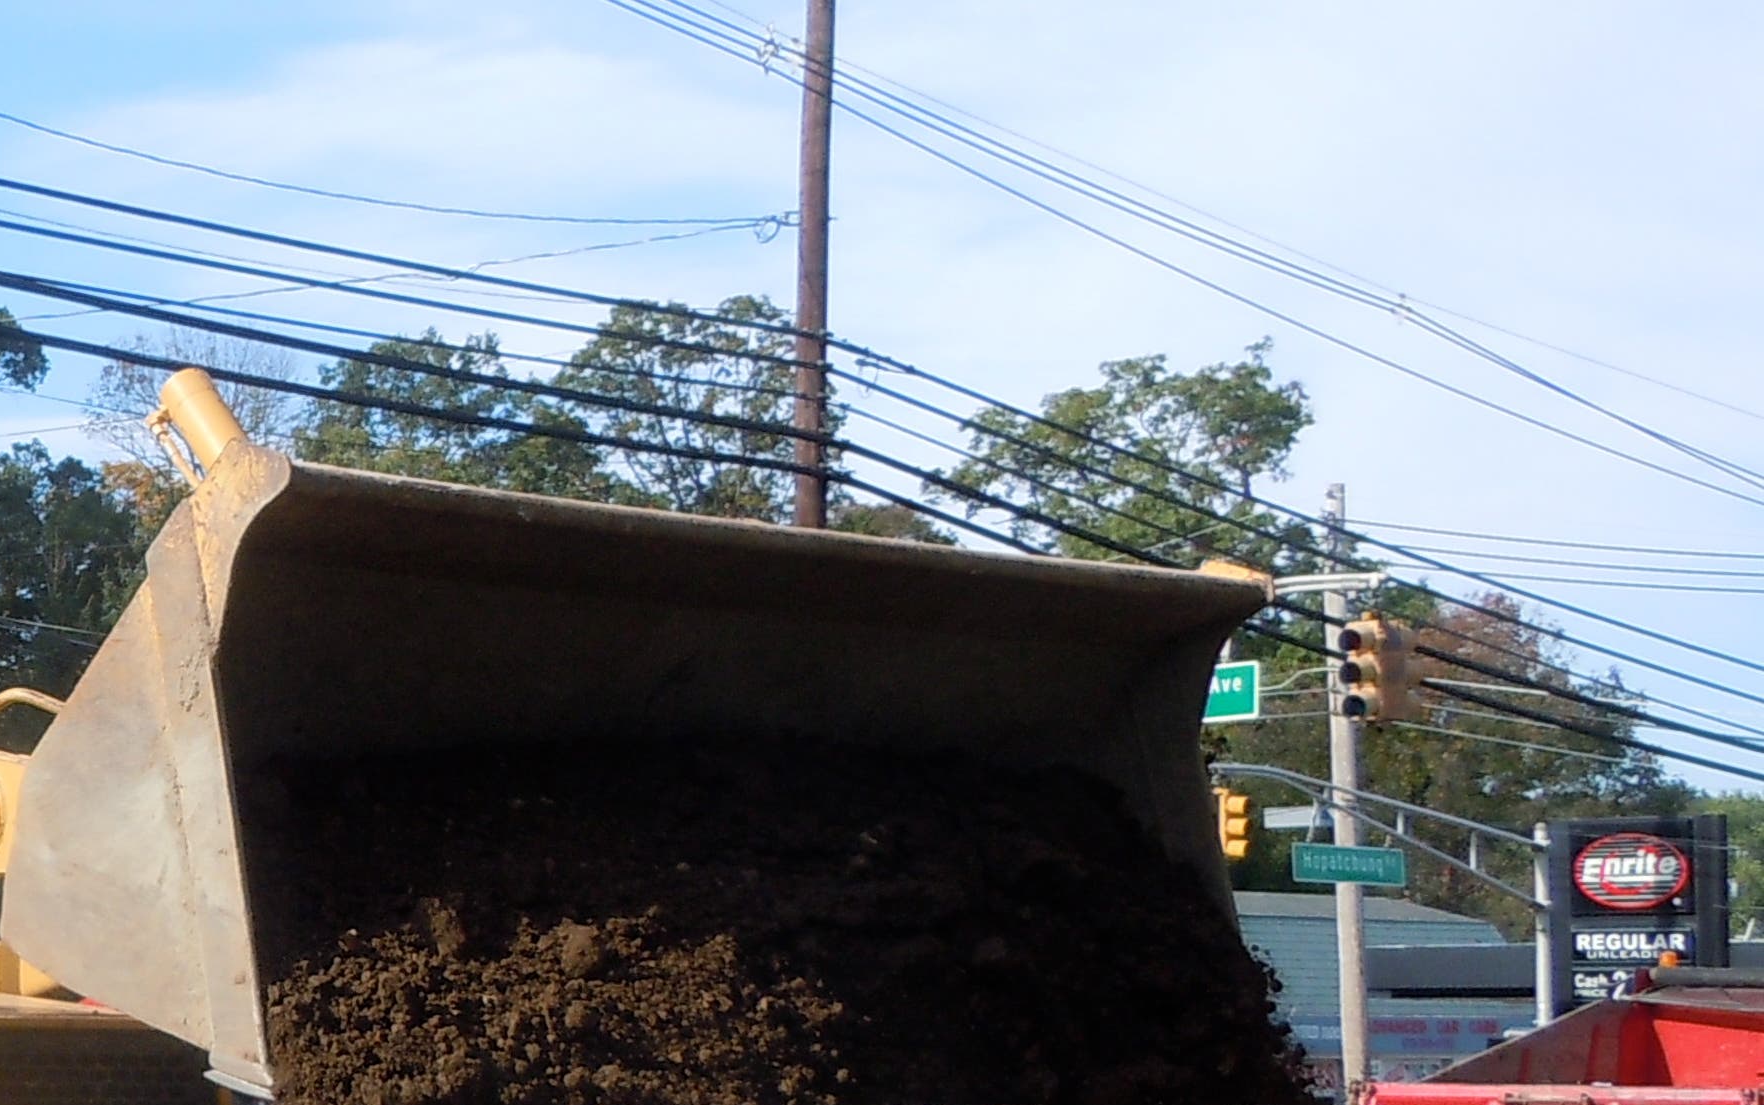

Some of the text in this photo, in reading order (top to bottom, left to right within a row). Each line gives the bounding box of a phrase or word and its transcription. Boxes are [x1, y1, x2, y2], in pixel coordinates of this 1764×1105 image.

[1209, 676, 1242, 693] Ave
[1581, 849, 1677, 882] Enrite
[1576, 933, 1686, 950] REGULAR
[1586, 950, 1661, 960] UNLEAD
[1574, 973, 1609, 988] Cash
